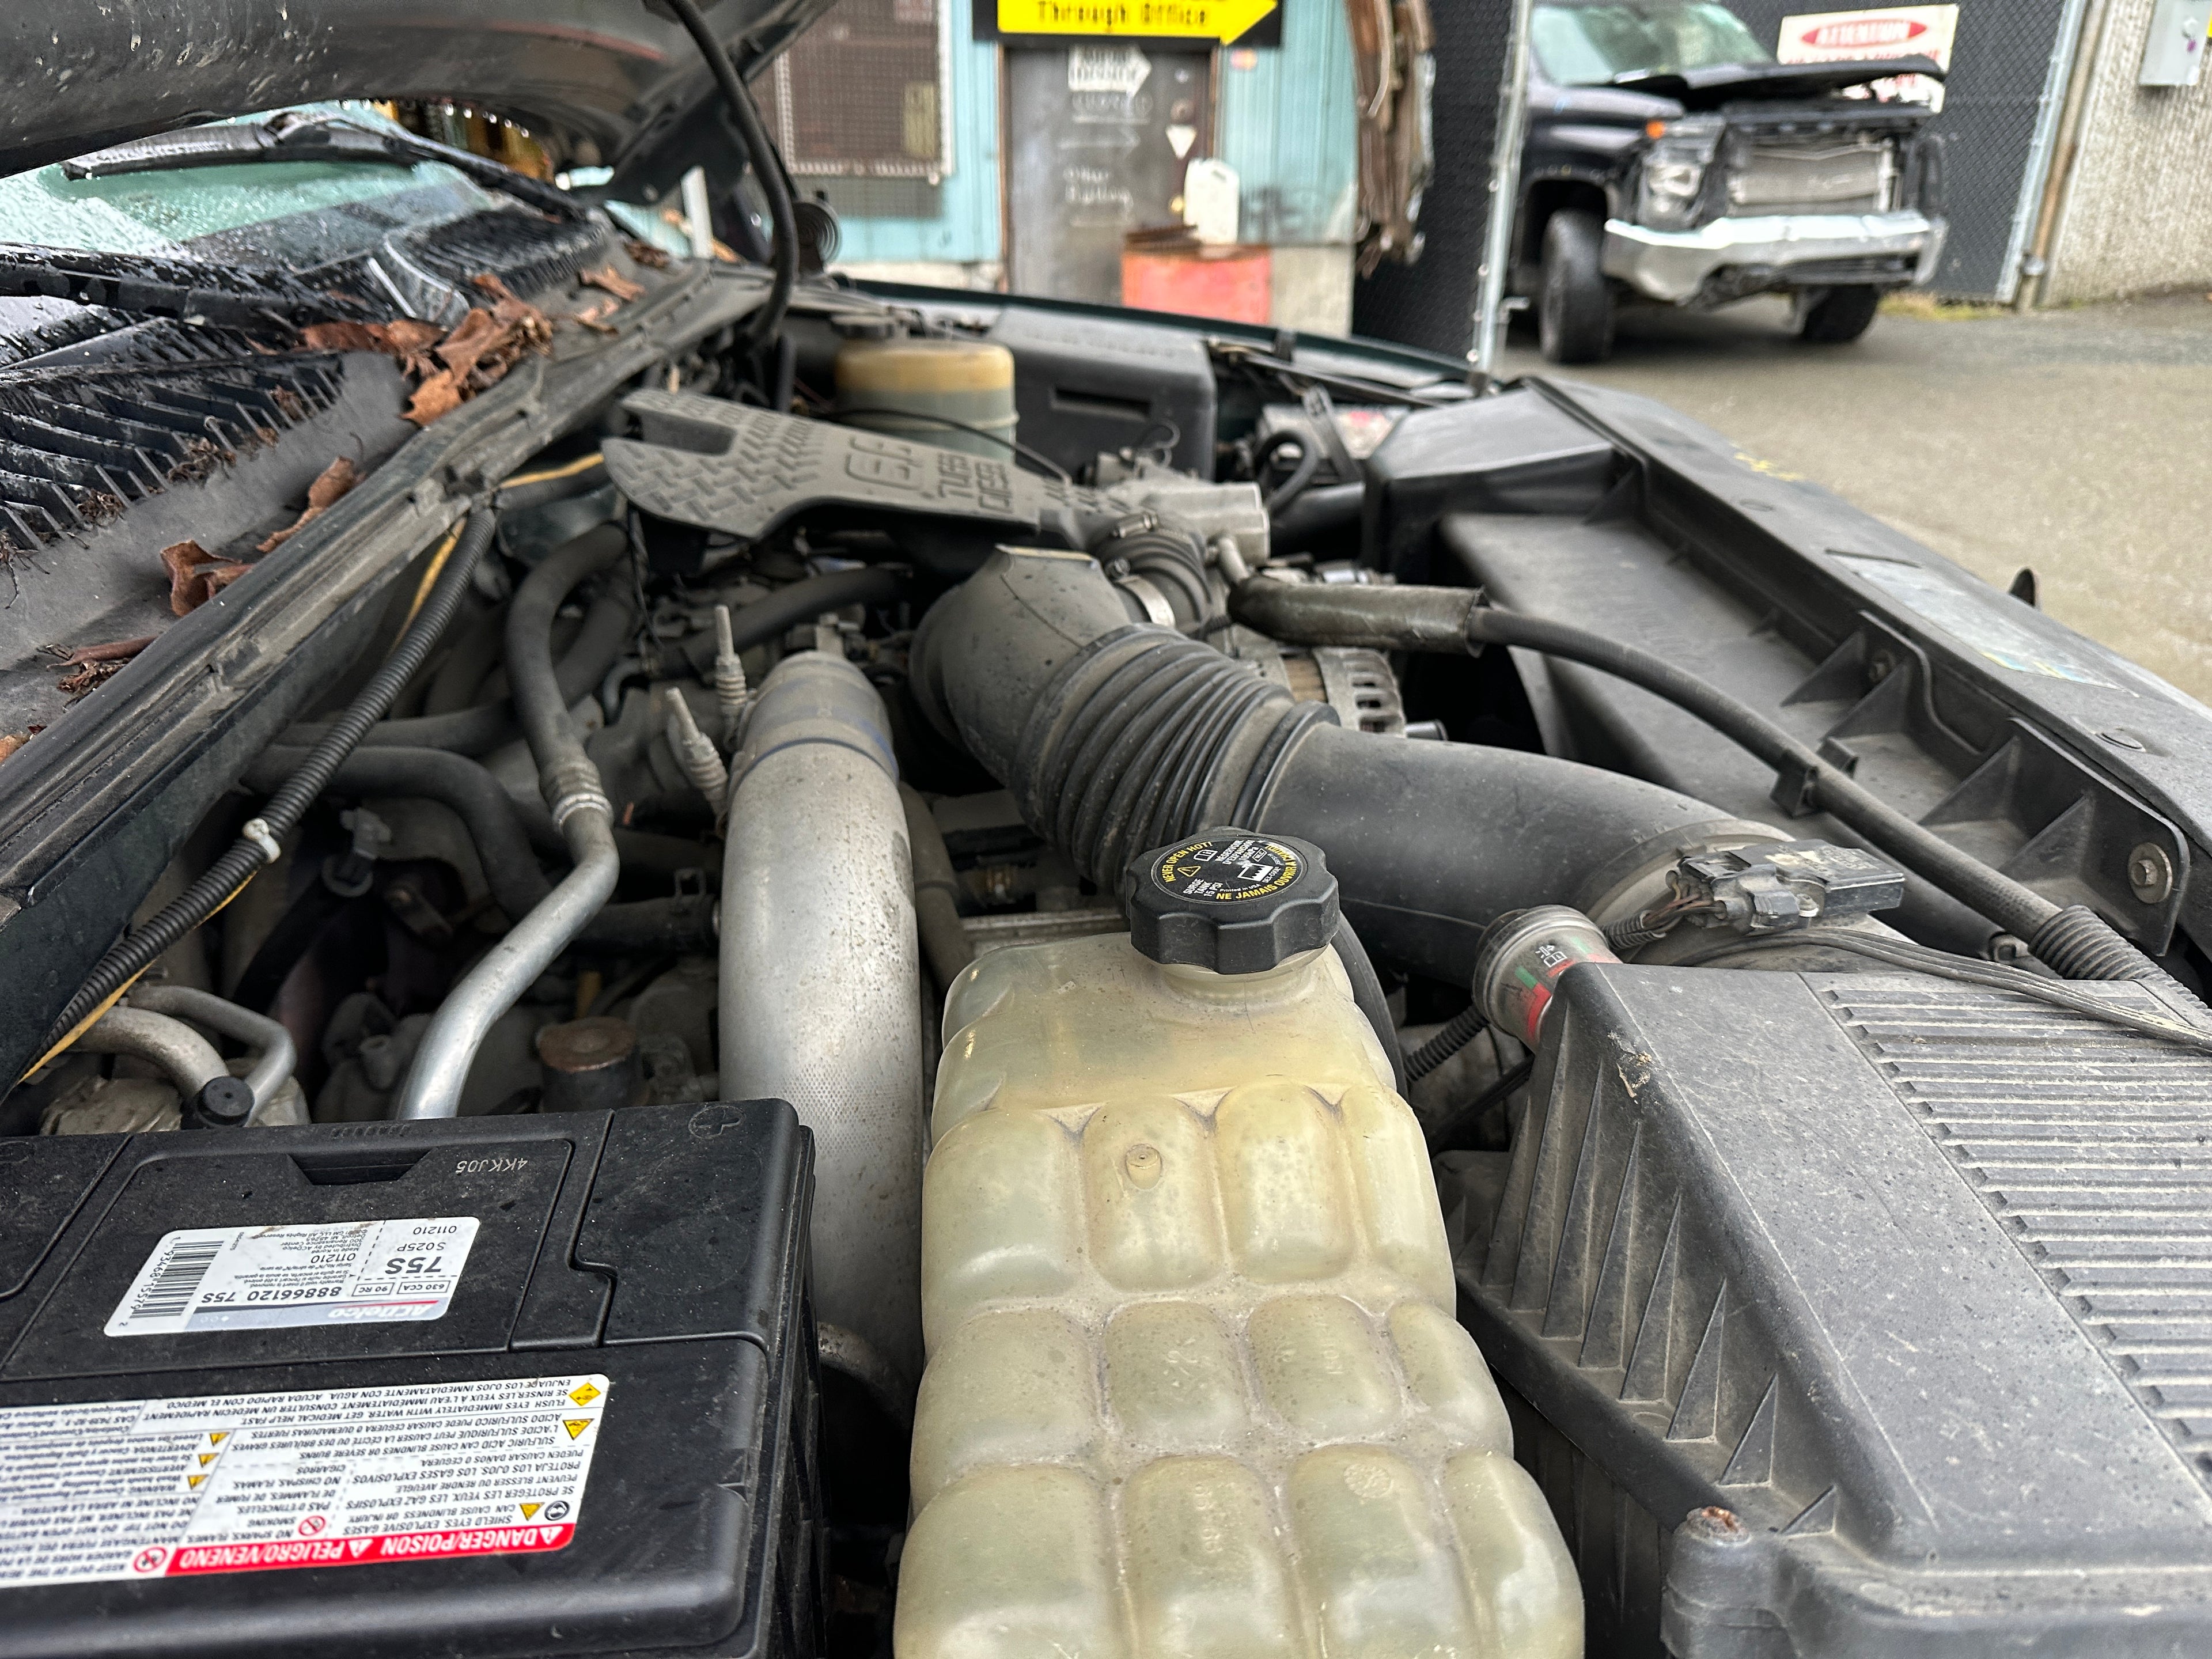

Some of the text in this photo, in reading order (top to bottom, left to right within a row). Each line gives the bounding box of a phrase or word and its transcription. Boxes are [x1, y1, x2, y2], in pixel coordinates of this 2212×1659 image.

[1039, 2, 1206, 31] Through Office
[1162, 842, 1213, 882] NEVER OPEN HOT!
[1183, 878, 1204, 894] SURGE
[1194, 881, 1213, 894] TANK
[1209, 882, 1223, 891] PSI
[1236, 884, 1278, 899] JAMAIS
[1274, 867, 1297, 886] OUVRIR
[456, 1158, 528, 1173] 4KKJ05
[411, 1224, 458, 1236] 011210
[309, 1252, 357, 1263] 011210
[381, 1254, 447, 1276] 75S
[127, 1250, 176, 1310] 93468 15579
[198, 1284, 343, 1304] 88866120 75S
[328, 1304, 432, 1320] ACDelco
[475, 1382, 502, 1391] OJOS
[504, 1381, 523, 1389] LOS
[359, 1389, 381, 1398] CON
[384, 1385, 474, 1397] INMEDIATAMENTE
[498, 1392, 516, 1400] LES
[517, 1390, 553, 1398] RINSER
[223, 1397, 244, 1406] CON
[247, 1395, 285, 1404] RAPIDO
[287, 1392, 323, 1402] ACUDA
[429, 1395, 458, 1404] L'EAU
[469, 1393, 496, 1402] YEUX
[209, 1399, 221, 1407] EL
[279, 1402, 338, 1413] CONSULTER
[504, 1401, 530, 1410] EYES
[534, 1399, 566, 1407] FLUSH
[262, 1406, 276, 1414] UN
[406, 1407, 433, 1415] WITH
[434, 1403, 502, 1414] IMMEDIATELY
[268, 1414, 294, 1423] HELP
[296, 1412, 342, 1422] MEDICAL
[344, 1411, 363, 1419] GET
[364, 1422, 405, 1432] CEGUERA
[406, 1421, 442, 1430] CAUSAR
[444, 1418, 473, 1427] PUEDE
[291, 1425, 354, 1436] QUEMADURAS
[457, 1427, 518, 1438] SULFURIQUE
[520, 1425, 558, 1434] L'ACIDE
[384, 1434, 395, 1443] LA
[396, 1432, 431, 1442] CAUSER
[433, 1431, 456, 1440] PEUT
[317, 1438, 335, 1446] DES
[336, 1437, 350, 1445] OU
[460, 1441, 480, 1449] CAN
[481, 1439, 506, 1448] ACID
[506, 1436, 555, 1446] SULFURIC
[382, 1444, 427, 1454] BLINDNES
[428, 1442, 458, 1451] CAUSE
[332, 1448, 366, 1457] SEVERE
[367, 1448, 381, 1456] OR
[508, 1452, 545, 1461] CAUSAR
[547, 1449, 584, 1459] PUEDEN
[472, 1454, 506, 1465] DAÑOS
[296, 1464, 345, 1475] CIGARROS
[351, 1460, 581, 1484] PROTEJA LOS OJOS. LOS GASES EXPLOSIVOS
[324, 1476, 340, 1484] NO
[478, 1479, 491, 1487] OU
[493, 1476, 534, 1486] BLESSER
[535, 1473, 578, 1483] PEUVENT
[438, 1480, 476, 1490] RENDRE
[561, 1485, 575, 1494] SE
[253, 1493, 266, 1502] DE
[321, 1489, 335, 1497] DE
[483, 1490, 502, 1499] LES
[503, 1486, 559, 1500] PROTÉGER
[344, 1496, 403, 1509] EXPLOSIFS
[404, 1495, 427, 1505] GAZ
[429, 1494, 448, 1503] LES
[308, 1501, 331, 1511] PAS
[348, 1503, 516, 1523] CAN CAUSE BLINDNESS OR INJURY.
[342, 1514, 513, 1535] SHIELD EYES. EXPLOSIVE GASES
[379, 1525, 540, 1558] DANGER/POISON
[178, 1537, 346, 1571] PELIGRO/VENENO
